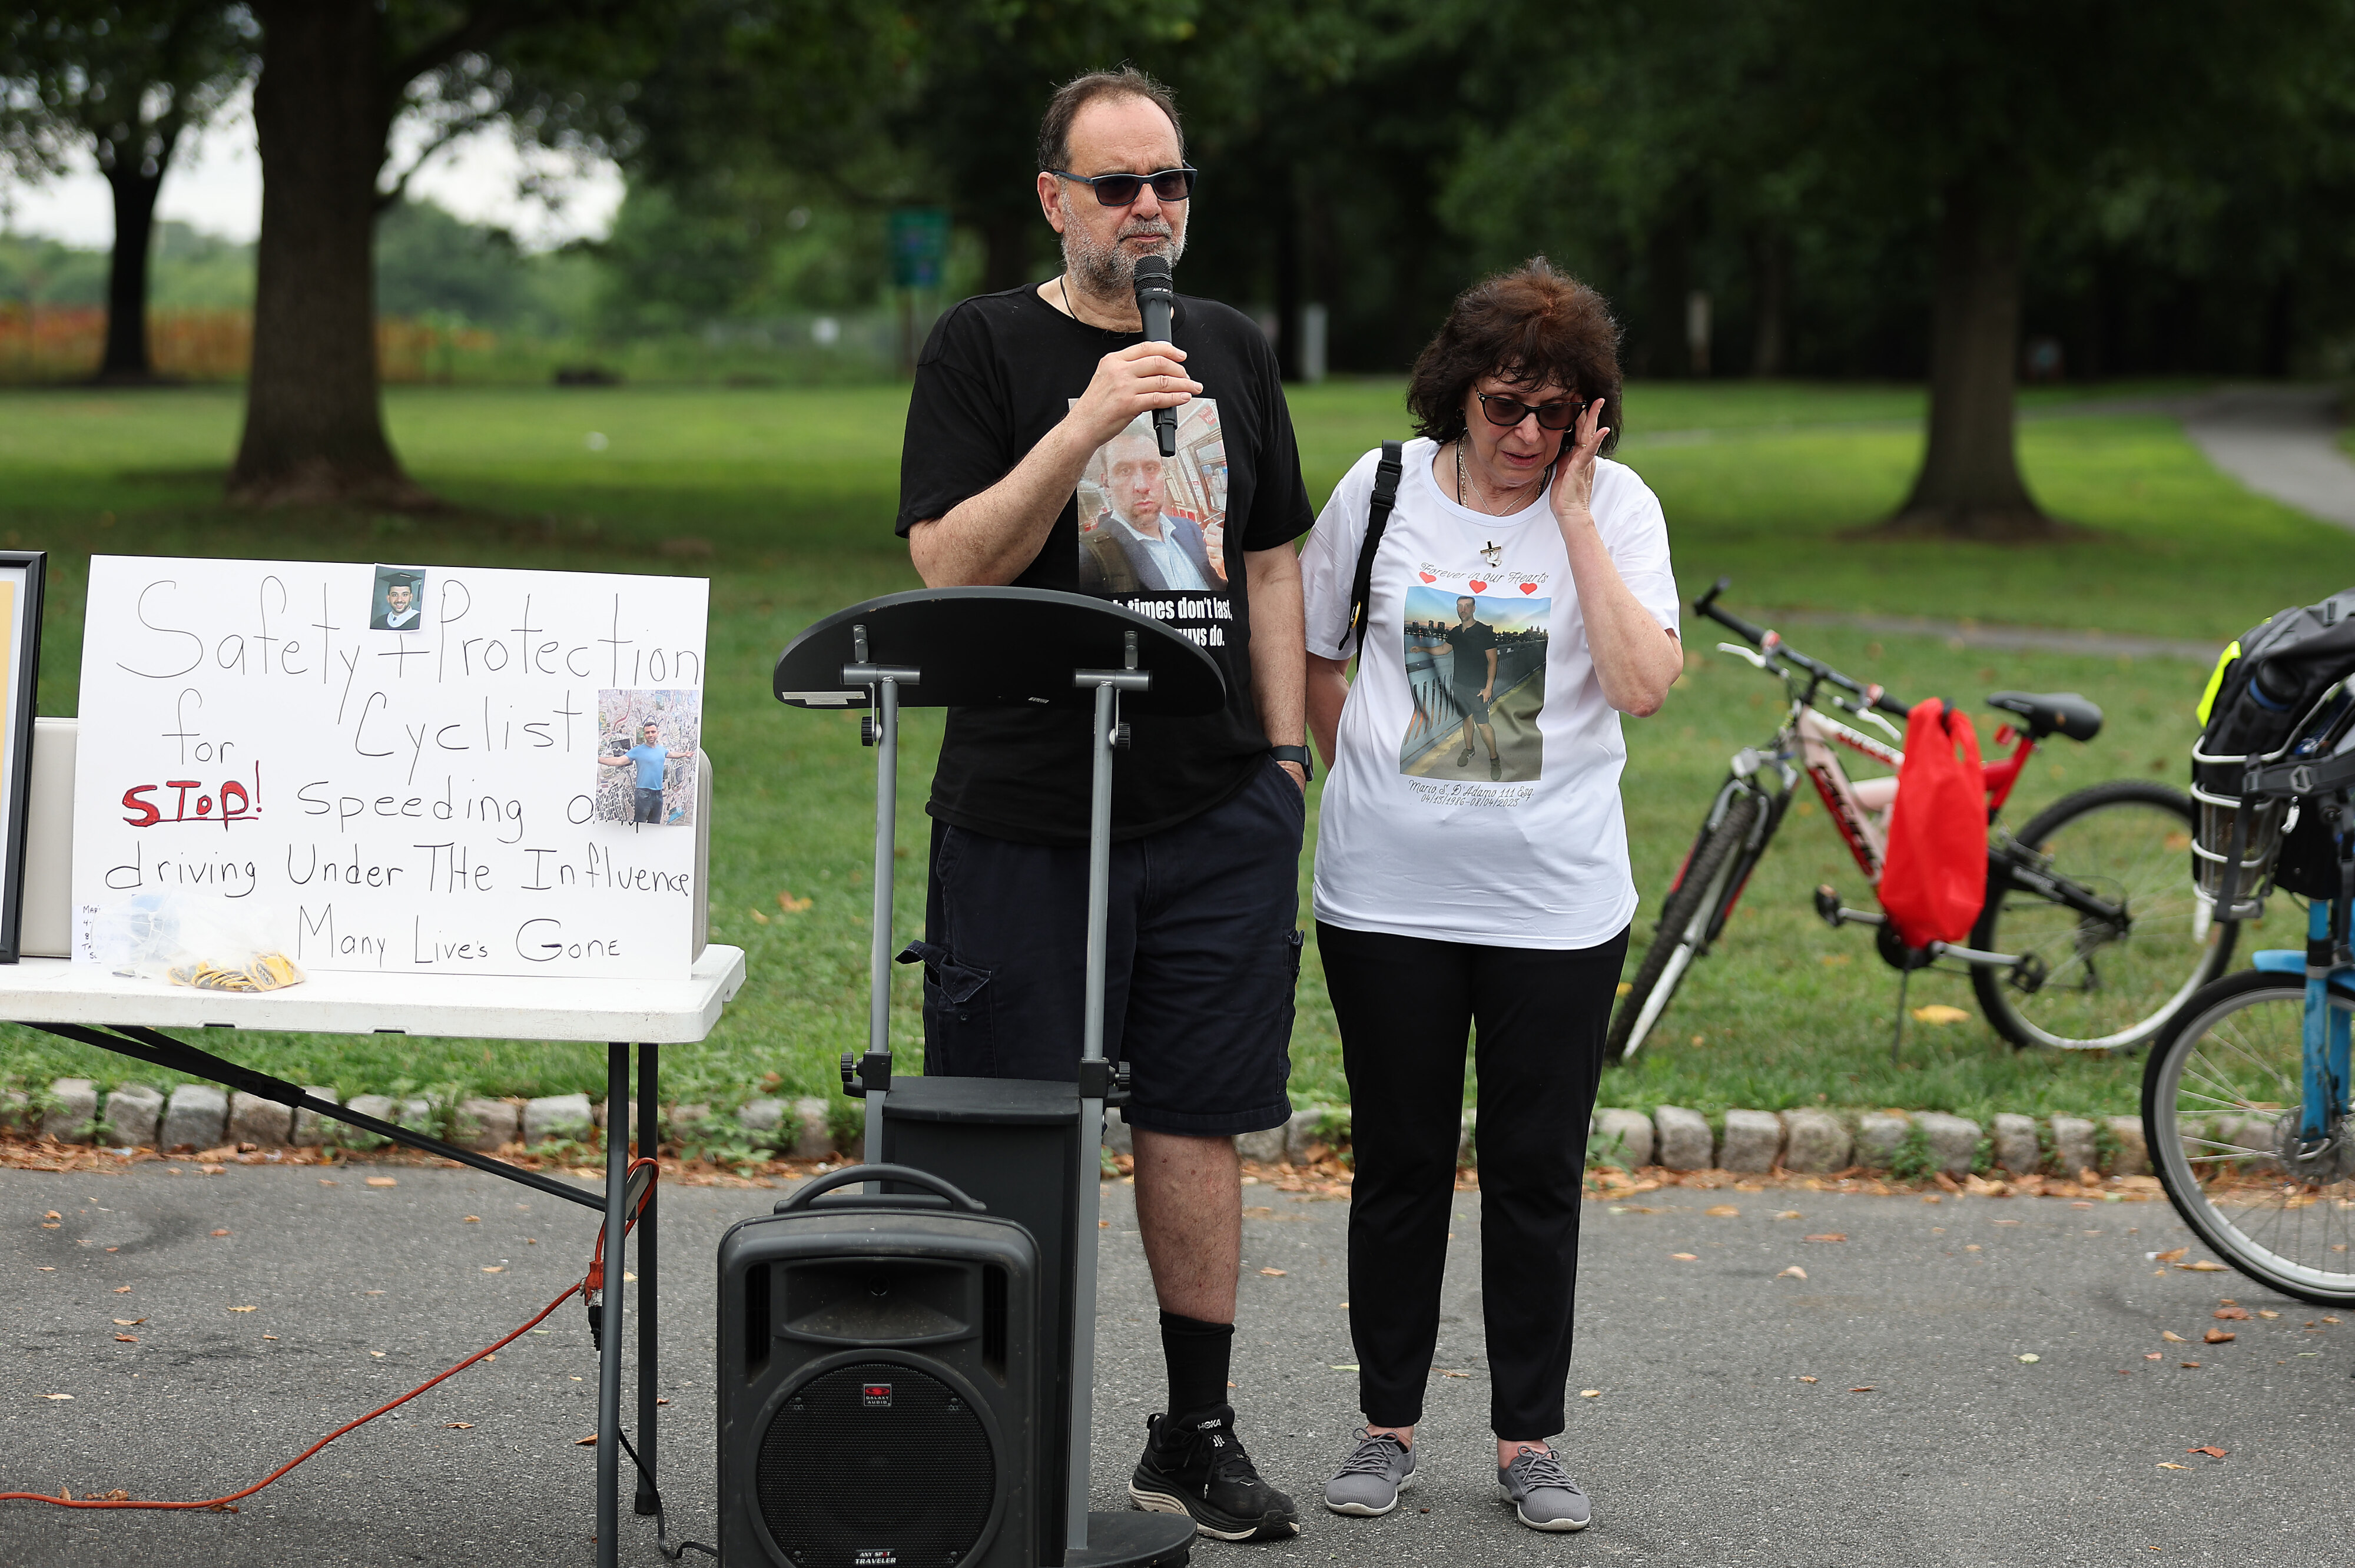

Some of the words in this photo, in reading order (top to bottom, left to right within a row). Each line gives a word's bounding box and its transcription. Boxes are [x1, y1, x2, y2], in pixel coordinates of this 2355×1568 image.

[1419, 562, 1467, 579] Forever
[1483, 572, 1505, 583] our
[1508, 572, 1549, 584] Hearts
[1178, 596, 1213, 619] don't
[1213, 597, 1233, 621] last,
[117, 576, 360, 724] Safety
[440, 579, 700, 687] Protection
[1175, 628, 1207, 647] uys
[1210, 624, 1225, 647] do.
[162, 688, 234, 765] for
[355, 690, 582, 785] Cyclist
[297, 775, 523, 843] Speeding
[1409, 780, 1437, 793] Mario
[1439, 784, 1450, 794] S.
[1451, 784, 1497, 797] D'Adamo
[1517, 785, 1534, 801] Esq.
[105, 841, 256, 897] driving
[288, 844, 404, 887] Under
[521, 842, 689, 896] Influence
[298, 903, 386, 968] Many
[1197, 1418, 1222, 1431] HOKA
